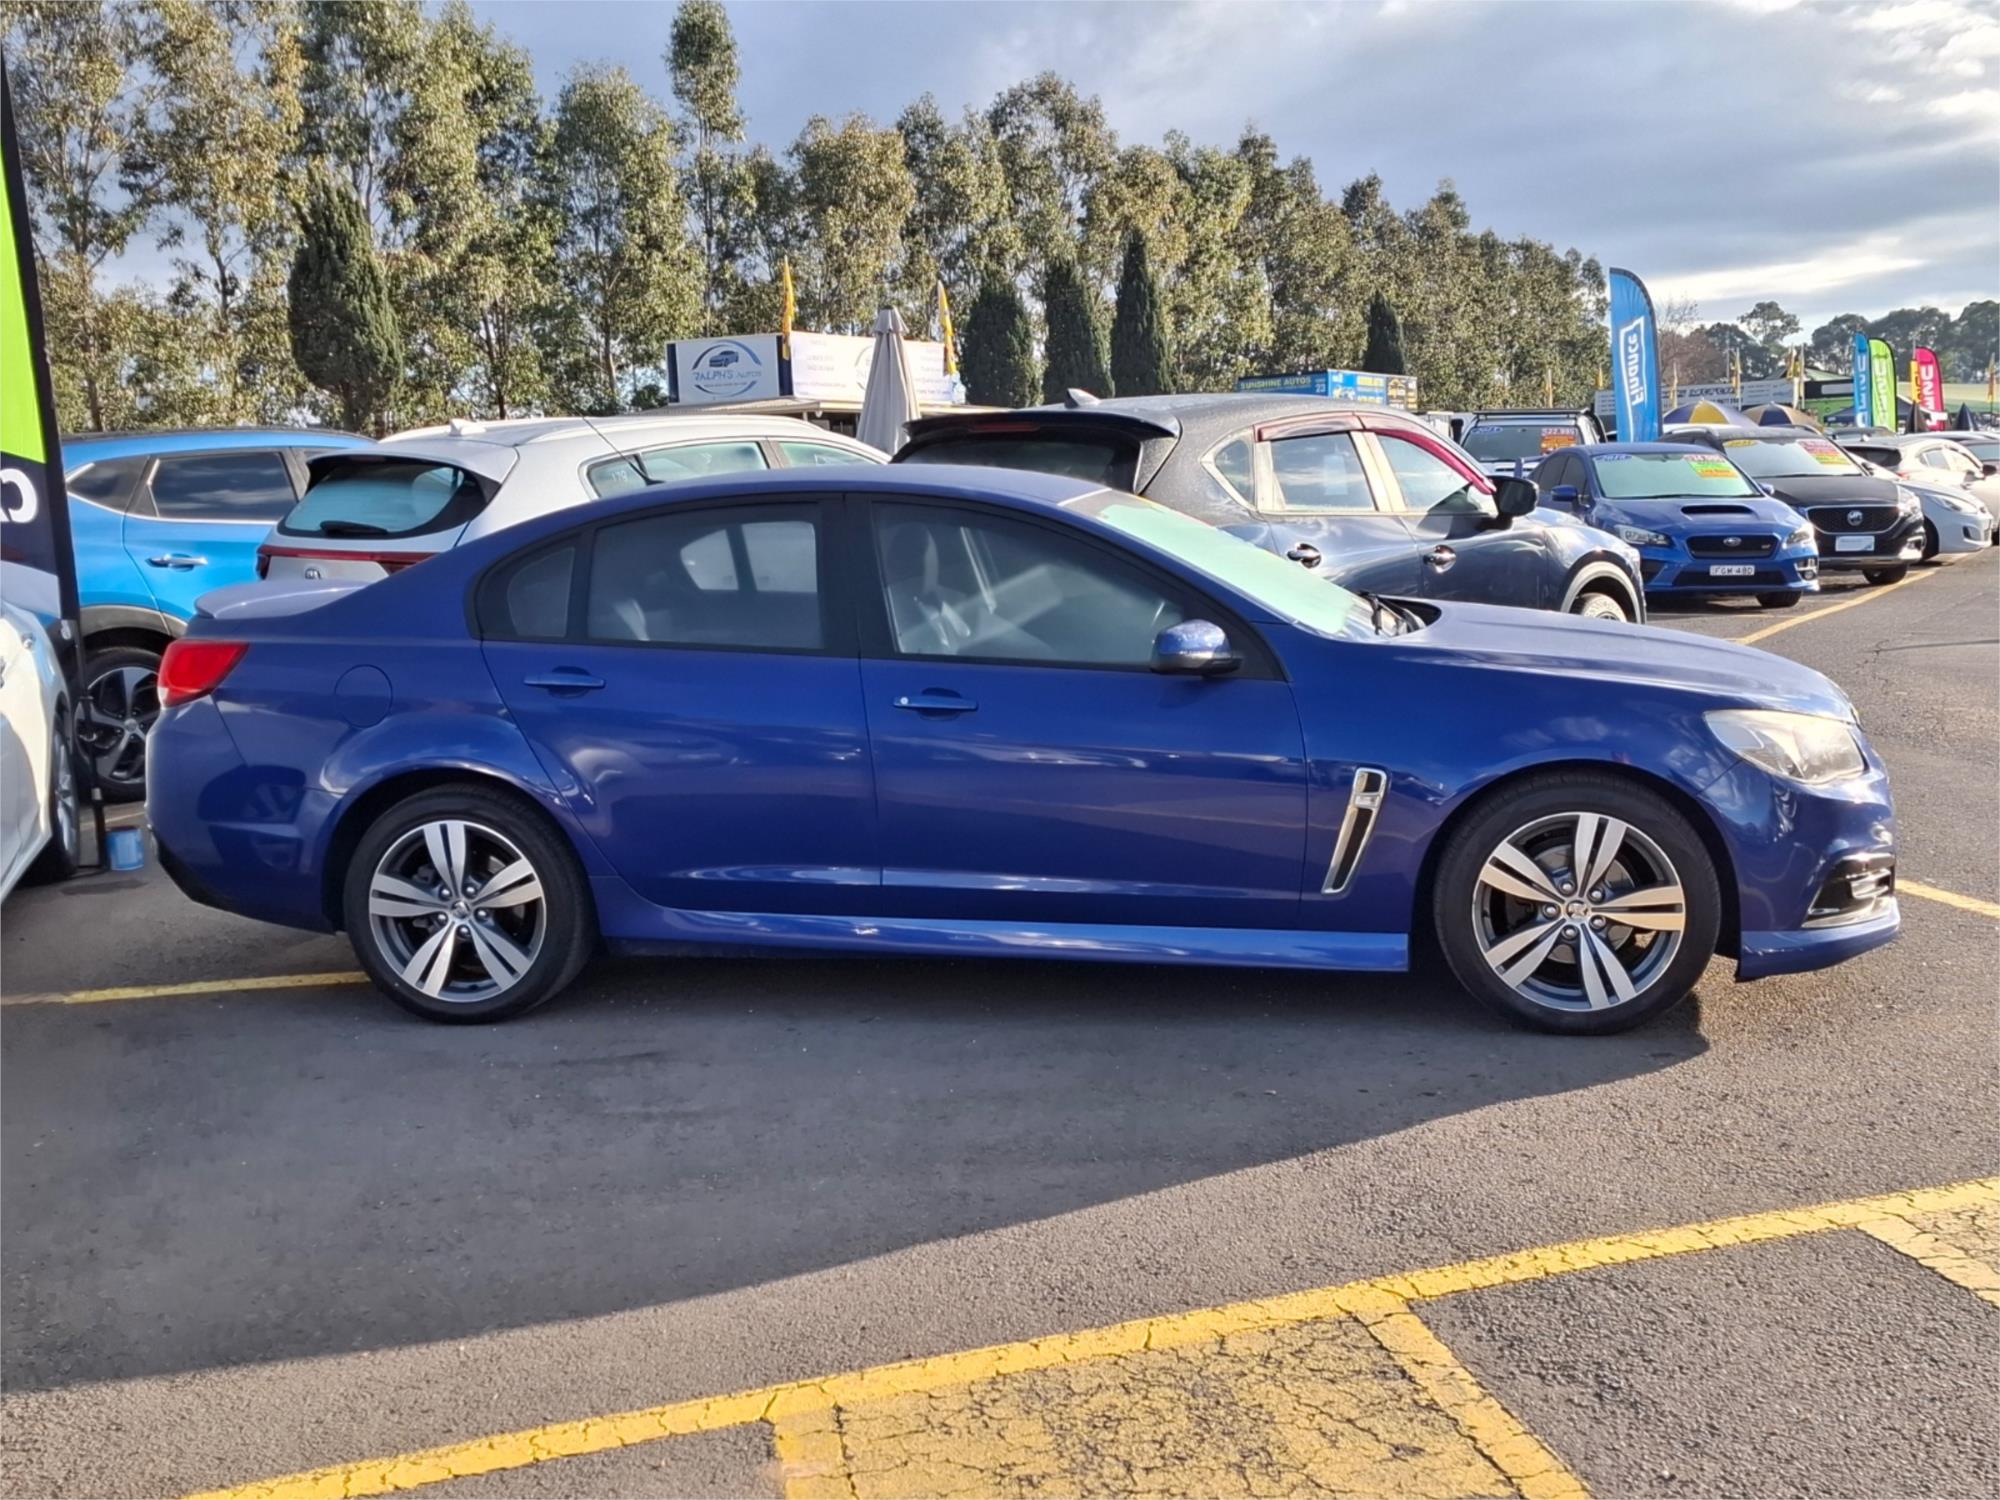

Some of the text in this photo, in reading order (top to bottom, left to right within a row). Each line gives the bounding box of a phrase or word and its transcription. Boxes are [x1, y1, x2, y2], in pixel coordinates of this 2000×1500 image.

[1240, 379, 1281, 390] SUNSHINE
[1284, 376, 1312, 386] AUTOS
[1628, 333, 1644, 406] Finance
